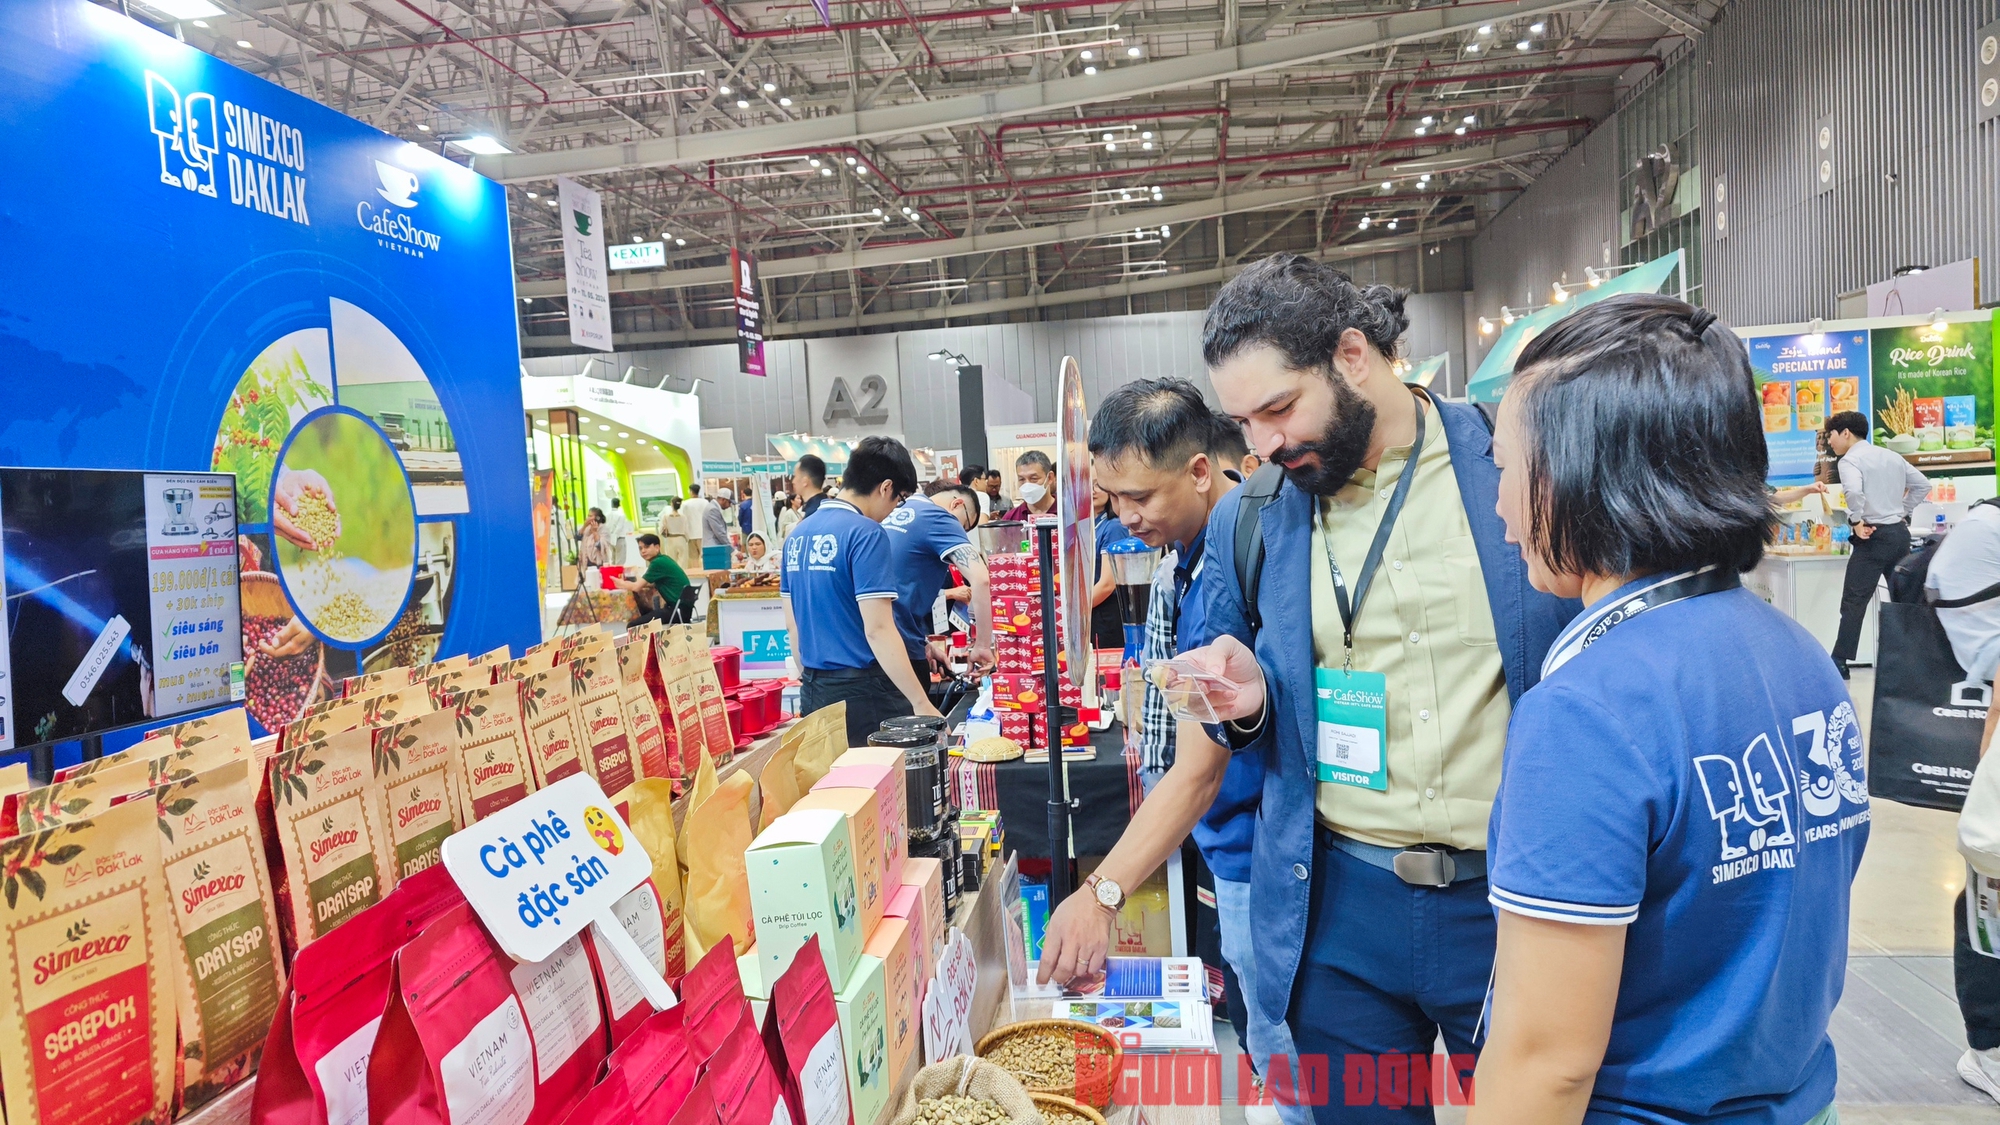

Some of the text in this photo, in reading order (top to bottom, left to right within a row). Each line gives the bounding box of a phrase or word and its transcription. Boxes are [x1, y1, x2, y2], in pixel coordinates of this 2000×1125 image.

[223, 100, 305, 172] SIMEXCO
[226, 152, 310, 226] DAKLAK
[356, 201, 441, 252] CafeShow
[378, 239, 424, 259] VIETNAM
[577, 239, 593, 261] Tea
[620, 246, 652, 259] EXIT
[575, 257, 598, 280] Show
[1781, 345, 1803, 358] Jeju
[1889, 342, 1976, 368] Rice Drink
[1771, 357, 1847, 374] SPECIALTY ADE
[1897, 366, 1967, 380] It's made of Korean Rice
[822, 374, 889, 426] A2
[1015, 432, 1048, 440] GUANGDONG
[229, 546, 234, 554] 1
[809, 533, 838, 565] 30
[152, 567, 218, 593] 199.000đ/1
[176, 596, 198, 612] 30k
[200, 593, 225, 610] ship
[172, 617, 224, 636] siêu sáng
[80, 630, 120, 689] 0346.025.543
[173, 645, 196, 660] siêu
[158, 675, 185, 689] mua
[1333, 688, 1384, 705] CafeShow
[589, 715, 619, 735] Simexco
[423, 744, 448, 759] Dak Lak
[542, 739, 570, 761] Simexco
[598, 749, 628, 773] SEREPOK
[1791, 700, 1870, 817] 30
[332, 768, 363, 786] Dak Lak
[473, 761, 515, 786] Simexco
[1331, 770, 1370, 785] VISITOR
[209, 806, 245, 826] Dak Lak
[397, 798, 442, 828] Simexco
[479, 809, 571, 879] Cà phê
[1804, 822, 1838, 844] YEARS
[310, 829, 359, 864] Simexco
[96, 854, 143, 877] Dak Lak
[403, 846, 442, 879] DRAYS
[1712, 854, 1759, 885] SIMEXCO
[182, 873, 246, 915] Simexco
[331, 877, 343, 890] CÔNG
[517, 854, 610, 929] đặc sản
[316, 875, 374, 923] DRAYSAP
[761, 910, 823, 925] CÀ PHÊ TÚI LỌC
[207, 921, 241, 943] CÔNG THỨC
[33, 934, 132, 985] Simexco
[194, 925, 264, 981] DRAYSAP
[526, 958, 566, 996] VIETNAM
[63, 990, 110, 1017] CÔNG THỨC
[43, 994, 137, 1060] SEREPOK
[468, 1032, 508, 1079] VIETNAM
